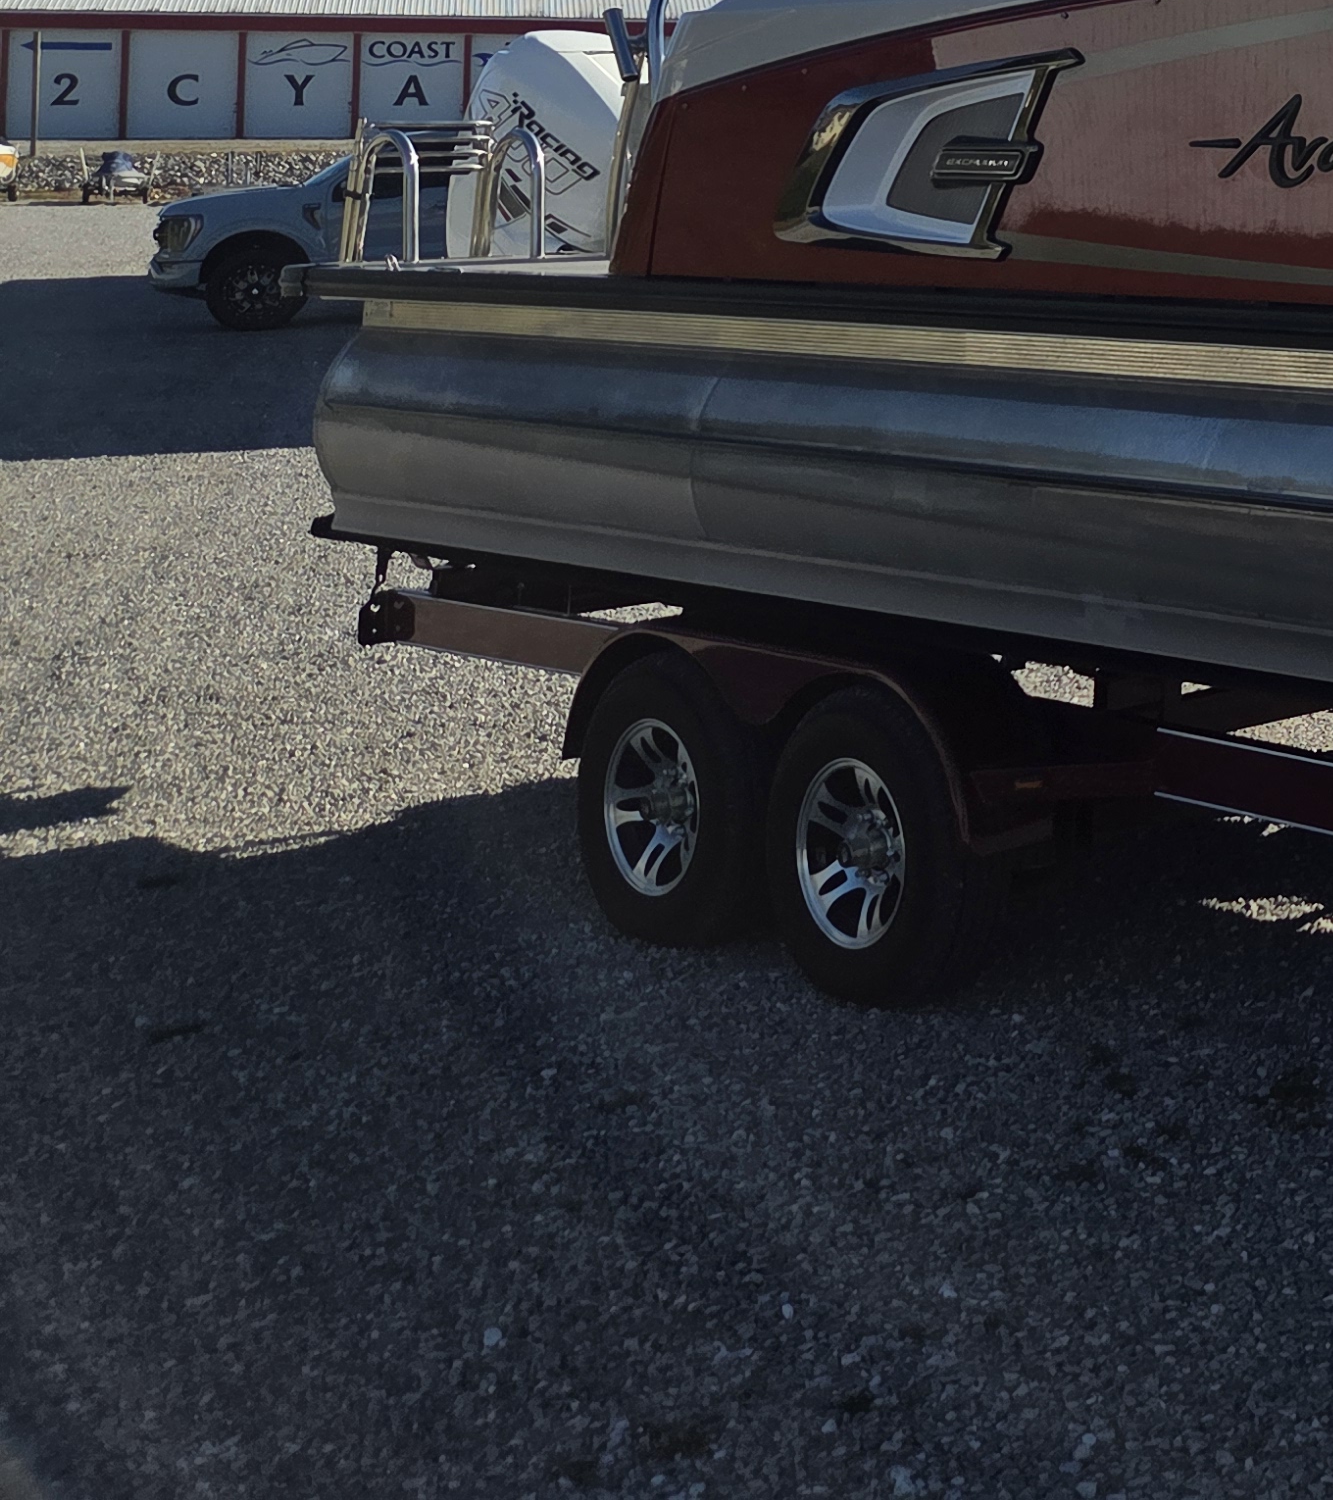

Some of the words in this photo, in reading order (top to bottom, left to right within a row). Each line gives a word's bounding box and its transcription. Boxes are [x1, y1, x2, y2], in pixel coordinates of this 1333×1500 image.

[368, 40, 456, 59] COAST
[50, 73, 80, 106] 2
[167, 74, 199, 106] C
[284, 75, 315, 106] Y
[393, 75, 429, 106] A
[511, 100, 600, 180] Racing
